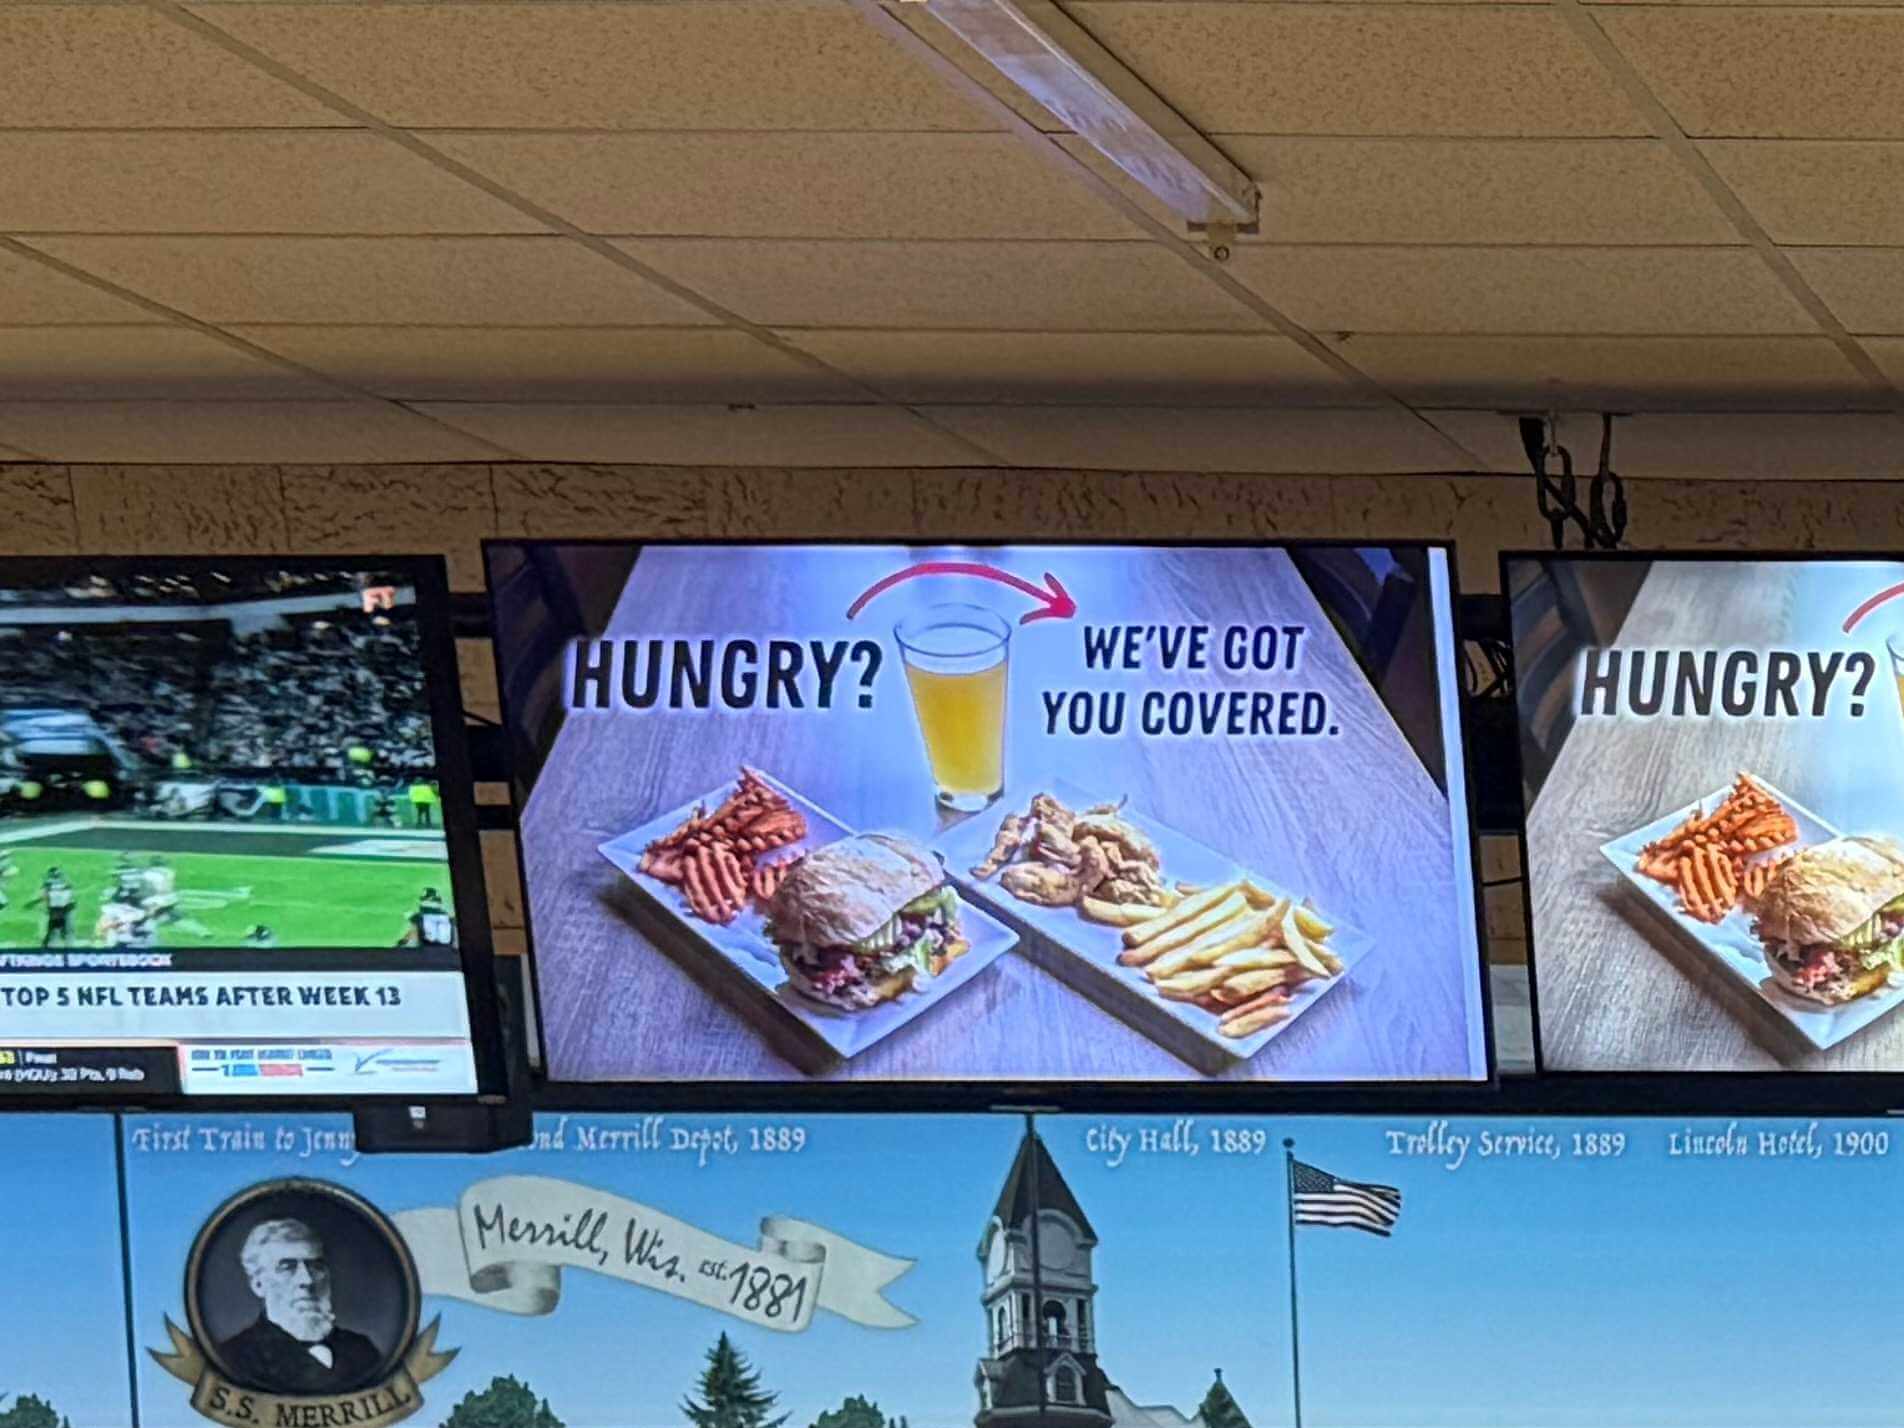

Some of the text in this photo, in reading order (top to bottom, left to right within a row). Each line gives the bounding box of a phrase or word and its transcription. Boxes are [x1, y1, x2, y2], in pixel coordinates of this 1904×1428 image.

[1083, 624, 1306, 671] WE'VE GOT
[570, 637, 884, 710] HUNGRY?
[1582, 649, 1876, 718] HUNGRY?
[1041, 691, 1342, 737] YOU COVERED.
[1, 986, 402, 1007] TOP 5 NFL TEAMS AFTER WEEK 13
[131, 1121, 191, 1153] First
[197, 1122, 266, 1153] Train
[275, 1121, 295, 1152] to
[576, 1114, 664, 1152] Merrill
[750, 1127, 806, 1153] 1889
[1086, 1119, 1267, 1167] City Hall, 1889
[1385, 1118, 1626, 1170] Trolley Service, 1889
[1668, 1121, 1890, 1159] Lincoln Hotel, 1900
[474, 1203, 611, 1268] Merrill,
[623, 1217, 688, 1284] Wis.
[729, 1260, 808, 1322] 1881
[209, 1384, 413, 1428] S.S. MERRILL
